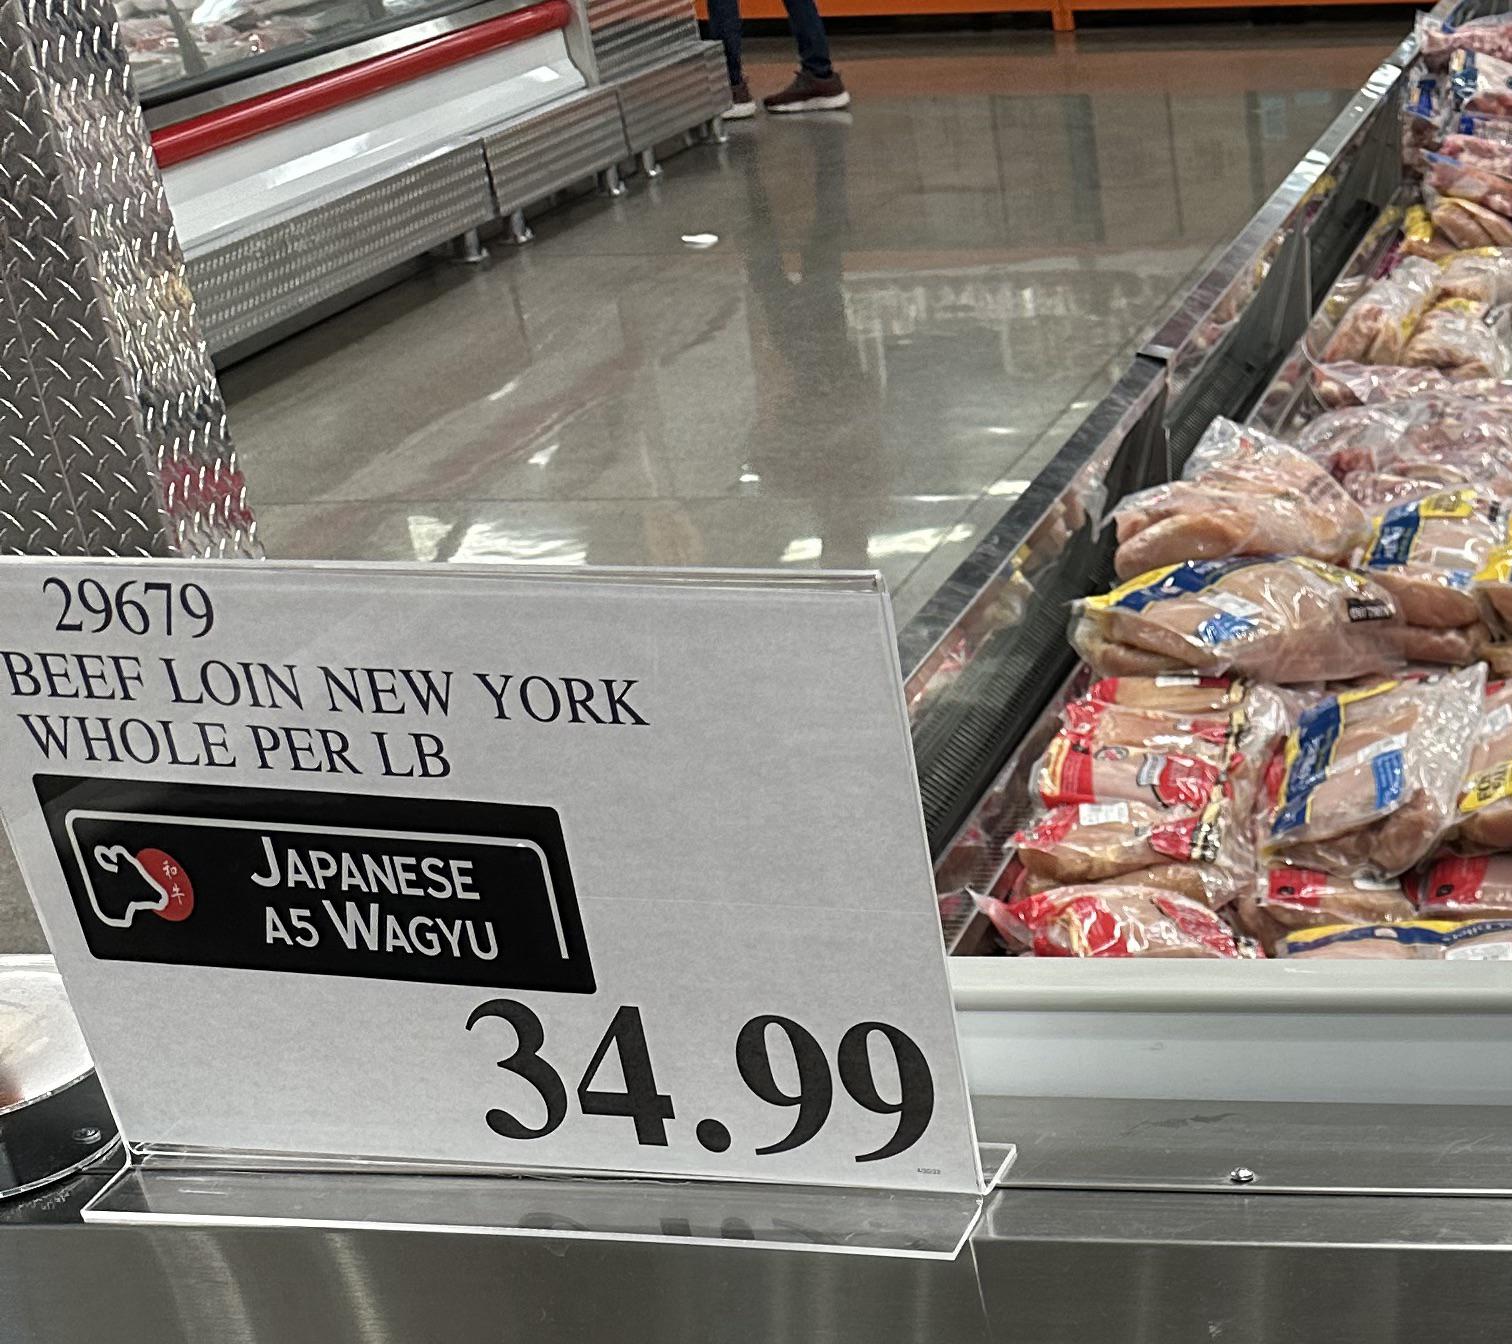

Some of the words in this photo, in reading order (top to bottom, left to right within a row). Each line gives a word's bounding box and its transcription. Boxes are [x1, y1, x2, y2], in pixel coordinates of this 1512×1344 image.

[41, 577, 215, 637] 29679
[0, 651, 145, 702] BEEF
[160, 658, 303, 710] LOIN
[318, 666, 453, 717] NEW
[477, 673, 651, 725] YORK
[16, 714, 235, 769] WHOLE
[248, 723, 361, 775] PER
[374, 730, 453, 779] LB
[250, 835, 480, 901] JAPANESE
[264, 907, 320, 948] A5
[322, 899, 500, 961] WAGYU
[465, 998, 935, 1163] 34.99
